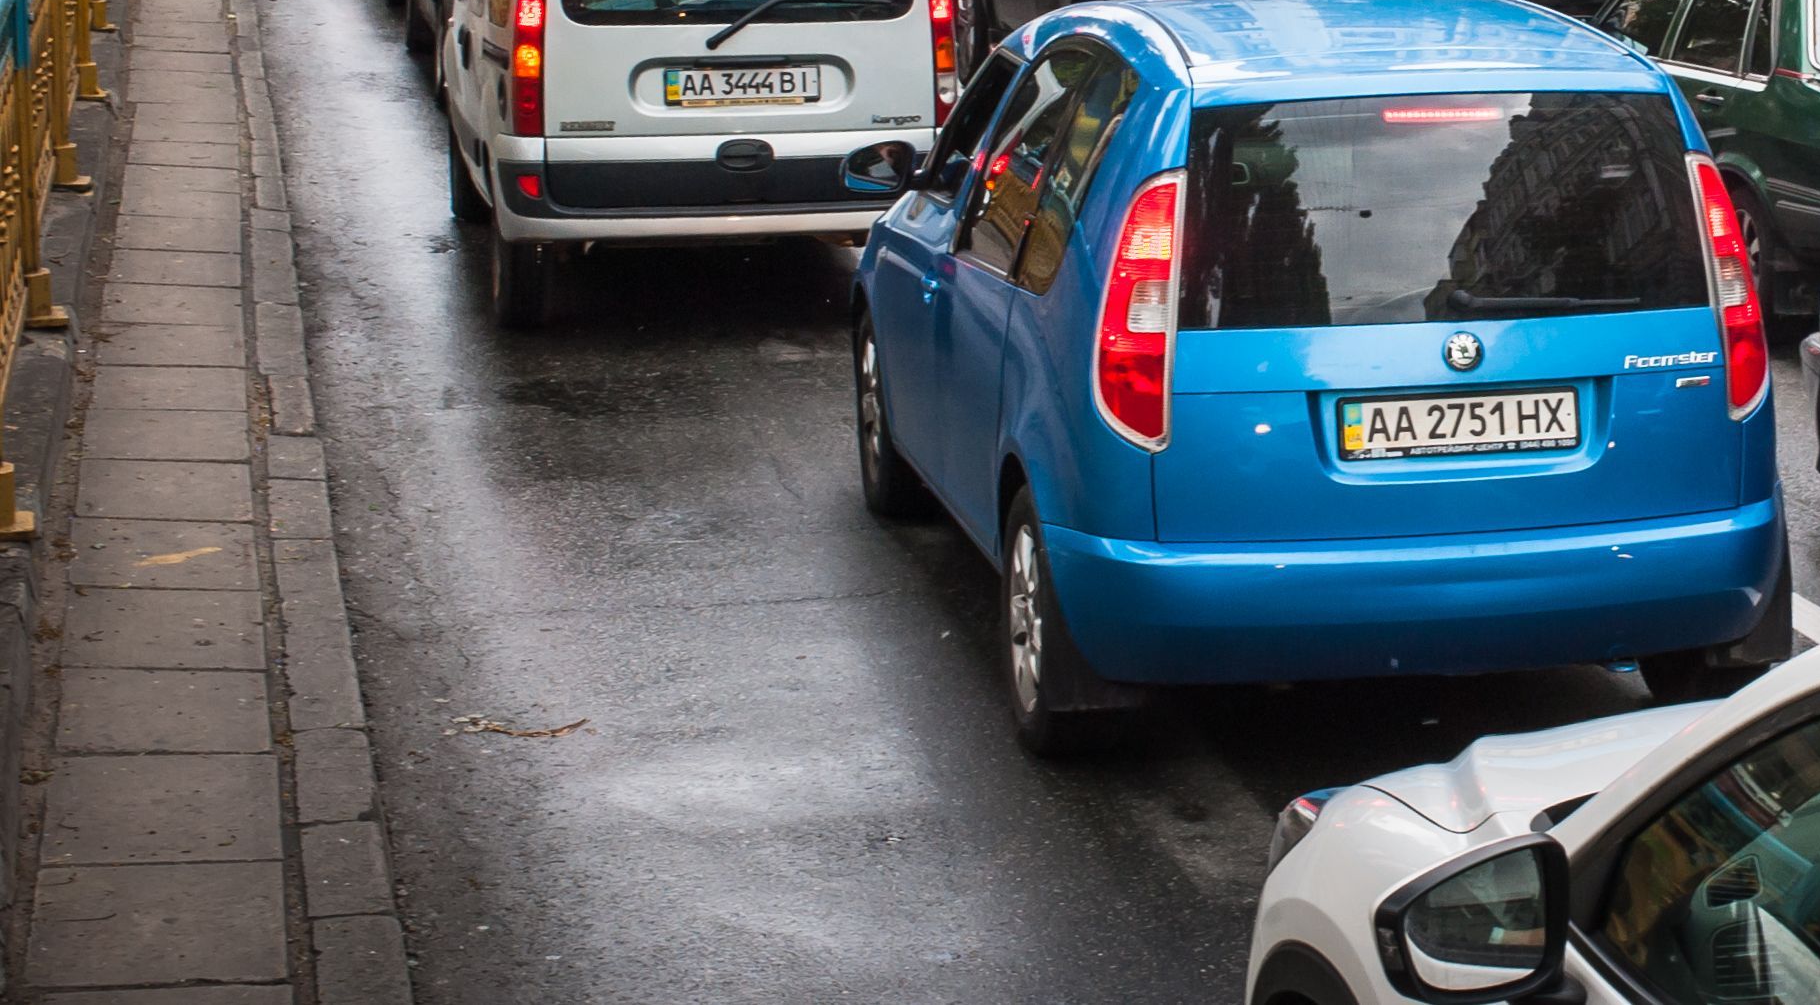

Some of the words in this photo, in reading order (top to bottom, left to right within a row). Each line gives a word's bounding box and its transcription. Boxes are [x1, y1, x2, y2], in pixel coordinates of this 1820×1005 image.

[682, 75, 715, 95] AA
[721, 72, 774, 95] 3444
[1368, 406, 1417, 442] AA
[1427, 401, 1506, 439] 2751
[1517, 398, 1565, 435] HX
